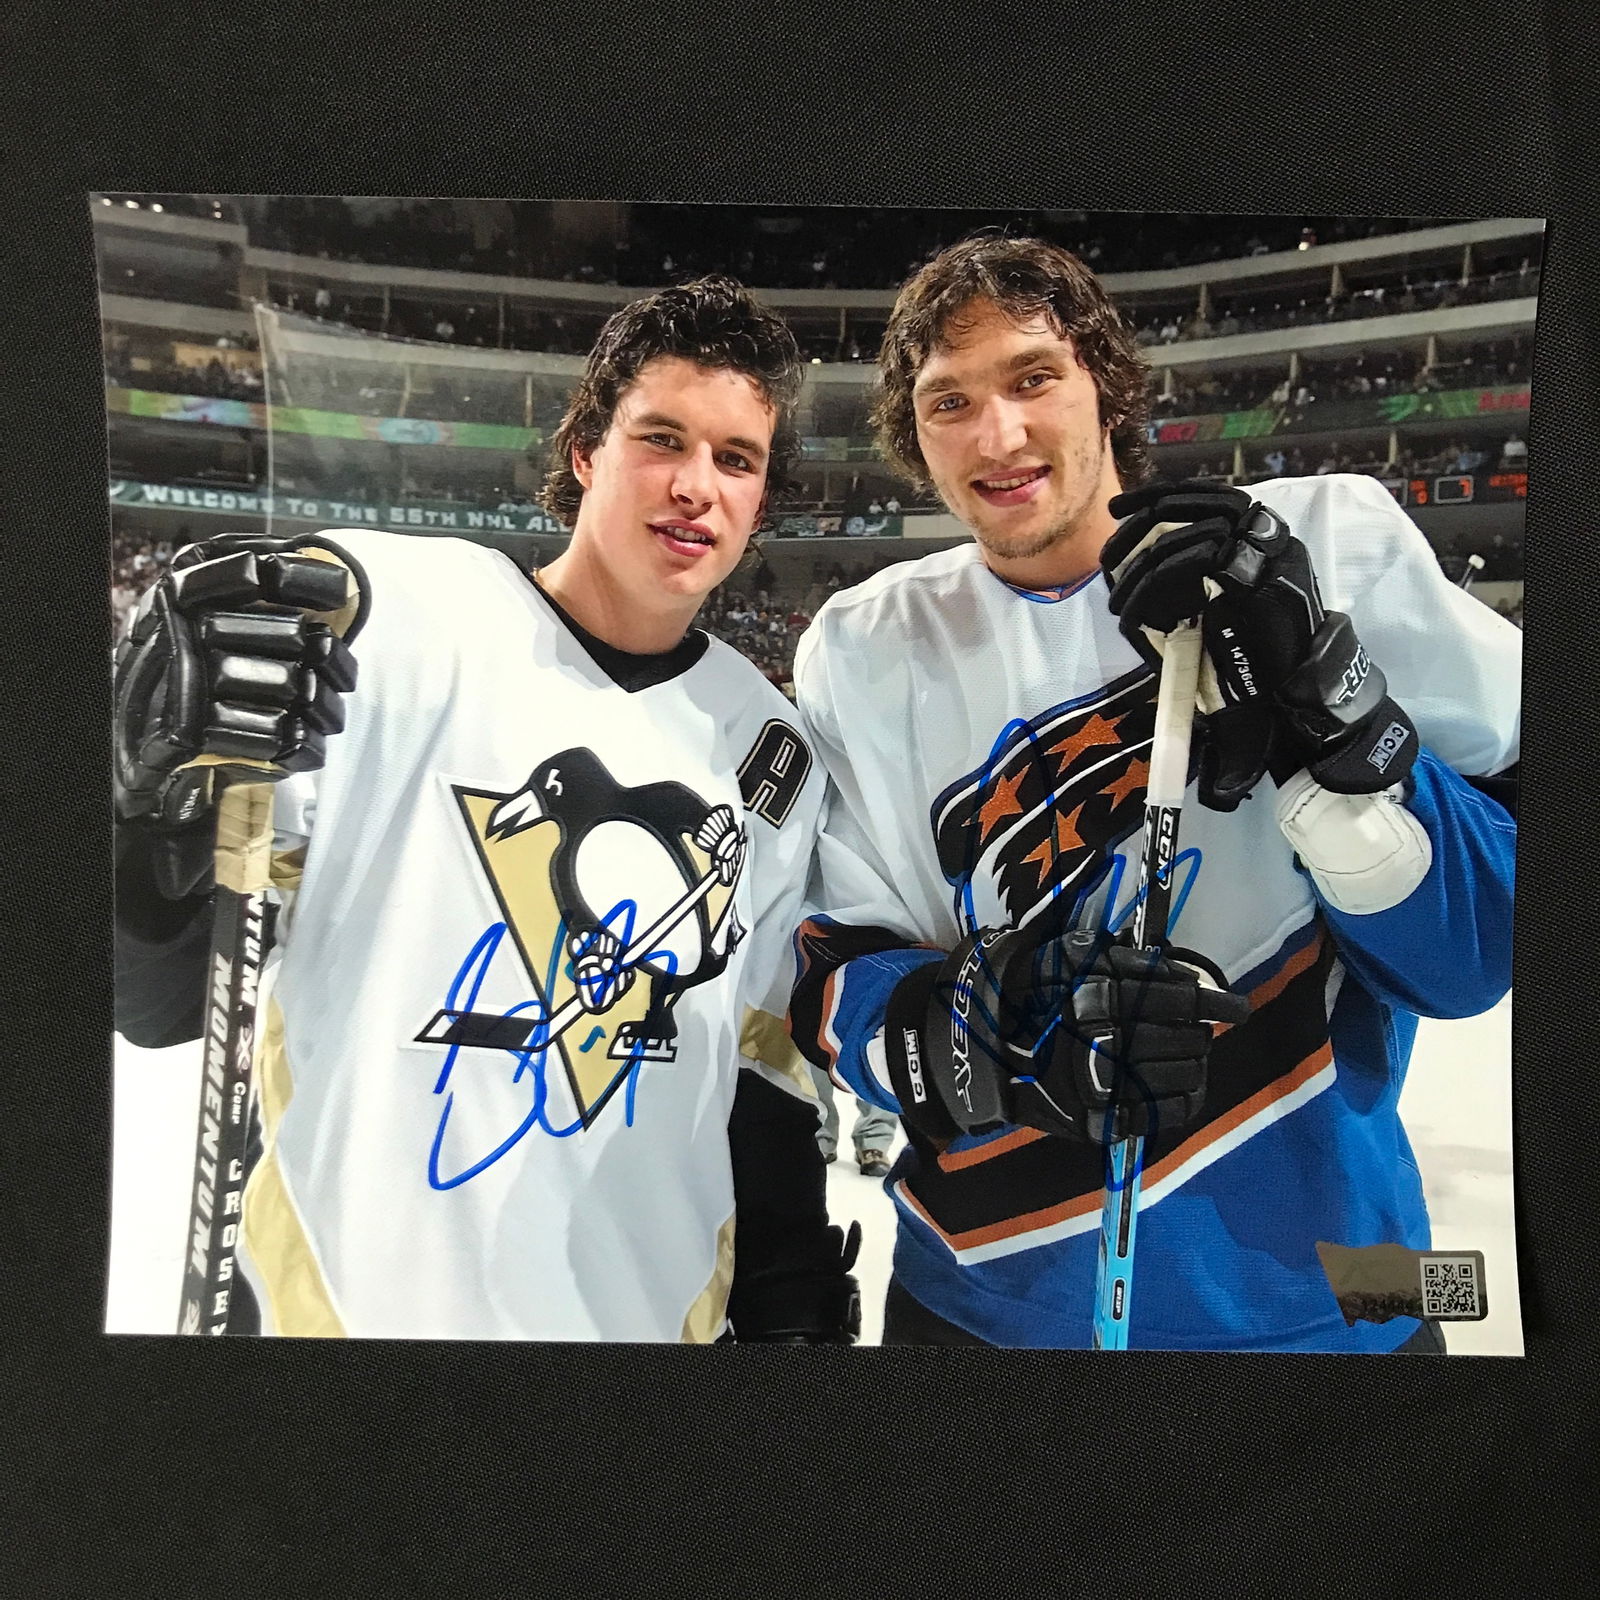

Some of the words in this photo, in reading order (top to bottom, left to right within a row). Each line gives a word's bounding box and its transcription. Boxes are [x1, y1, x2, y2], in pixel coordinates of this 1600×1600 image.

[142, 484, 274, 513] WELCOME
[286, 498, 318, 517] TO
[329, 502, 378, 522] THE
[467, 511, 516, 530] NHL
[1221, 628, 1234, 639] M
[1369, 724, 1407, 770] CCM
[905, 1029, 925, 1100] CCM
[190, 953, 234, 1278] MOMENTUM
